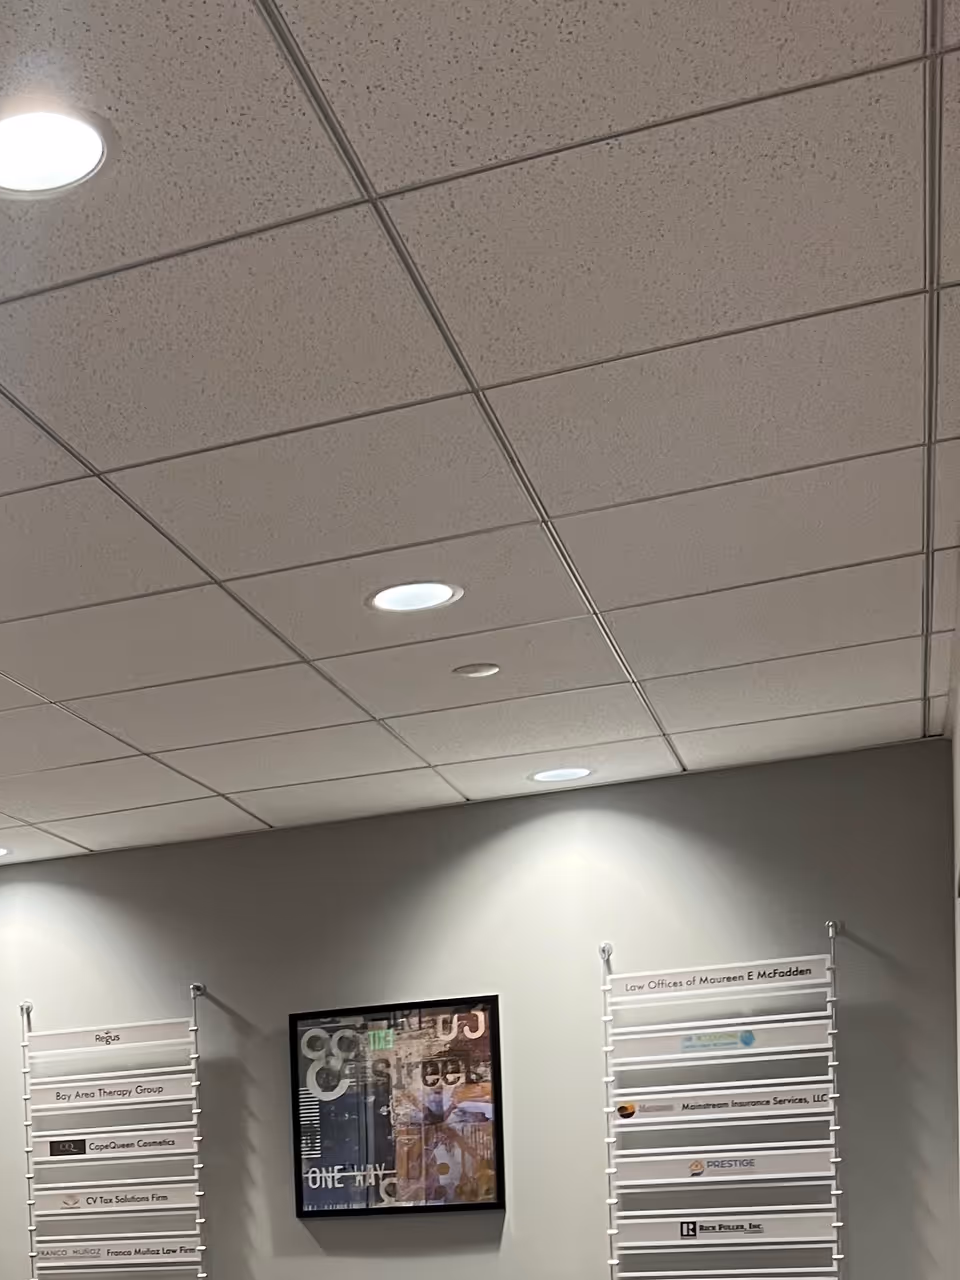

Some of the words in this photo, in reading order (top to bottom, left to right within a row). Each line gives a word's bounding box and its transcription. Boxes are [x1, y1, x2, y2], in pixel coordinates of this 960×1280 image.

[625, 983, 645, 992] Law
[648, 979, 683, 989] Offices
[686, 976, 697, 986] of
[699, 974, 744, 984] Maureen
[747, 972, 754, 980] E
[757, 967, 812, 979] McFadden
[95, 1033, 120, 1045] Regus
[55, 1092, 71, 1101] Bay
[74, 1090, 95, 1099] Area
[98, 1088, 132, 1099] Therapy
[135, 1085, 164, 1095] Group
[682, 1101, 730, 1111] Mainstream
[731, 1098, 771, 1107] Insurance
[772, 1095, 809, 1105] Services,
[813, 1094, 828, 1102] LLC
[89, 1141, 136, 1152] CapeQueen
[137, 1138, 175, 1148] Cosmetics
[707, 1159, 755, 1168] PRESTIGE
[308, 1166, 344, 1189] ONE
[354, 1163, 385, 1187] WAY
[86, 1197, 98, 1205] CV
[100, 1196, 113, 1204] Tax
[115, 1195, 150, 1204] Solutions
[151, 1194, 168, 1202] Firm
[107, 1248, 132, 1257] Franco
[162, 1247, 177, 1255] Law
[179, 1245, 196, 1254] Firm
